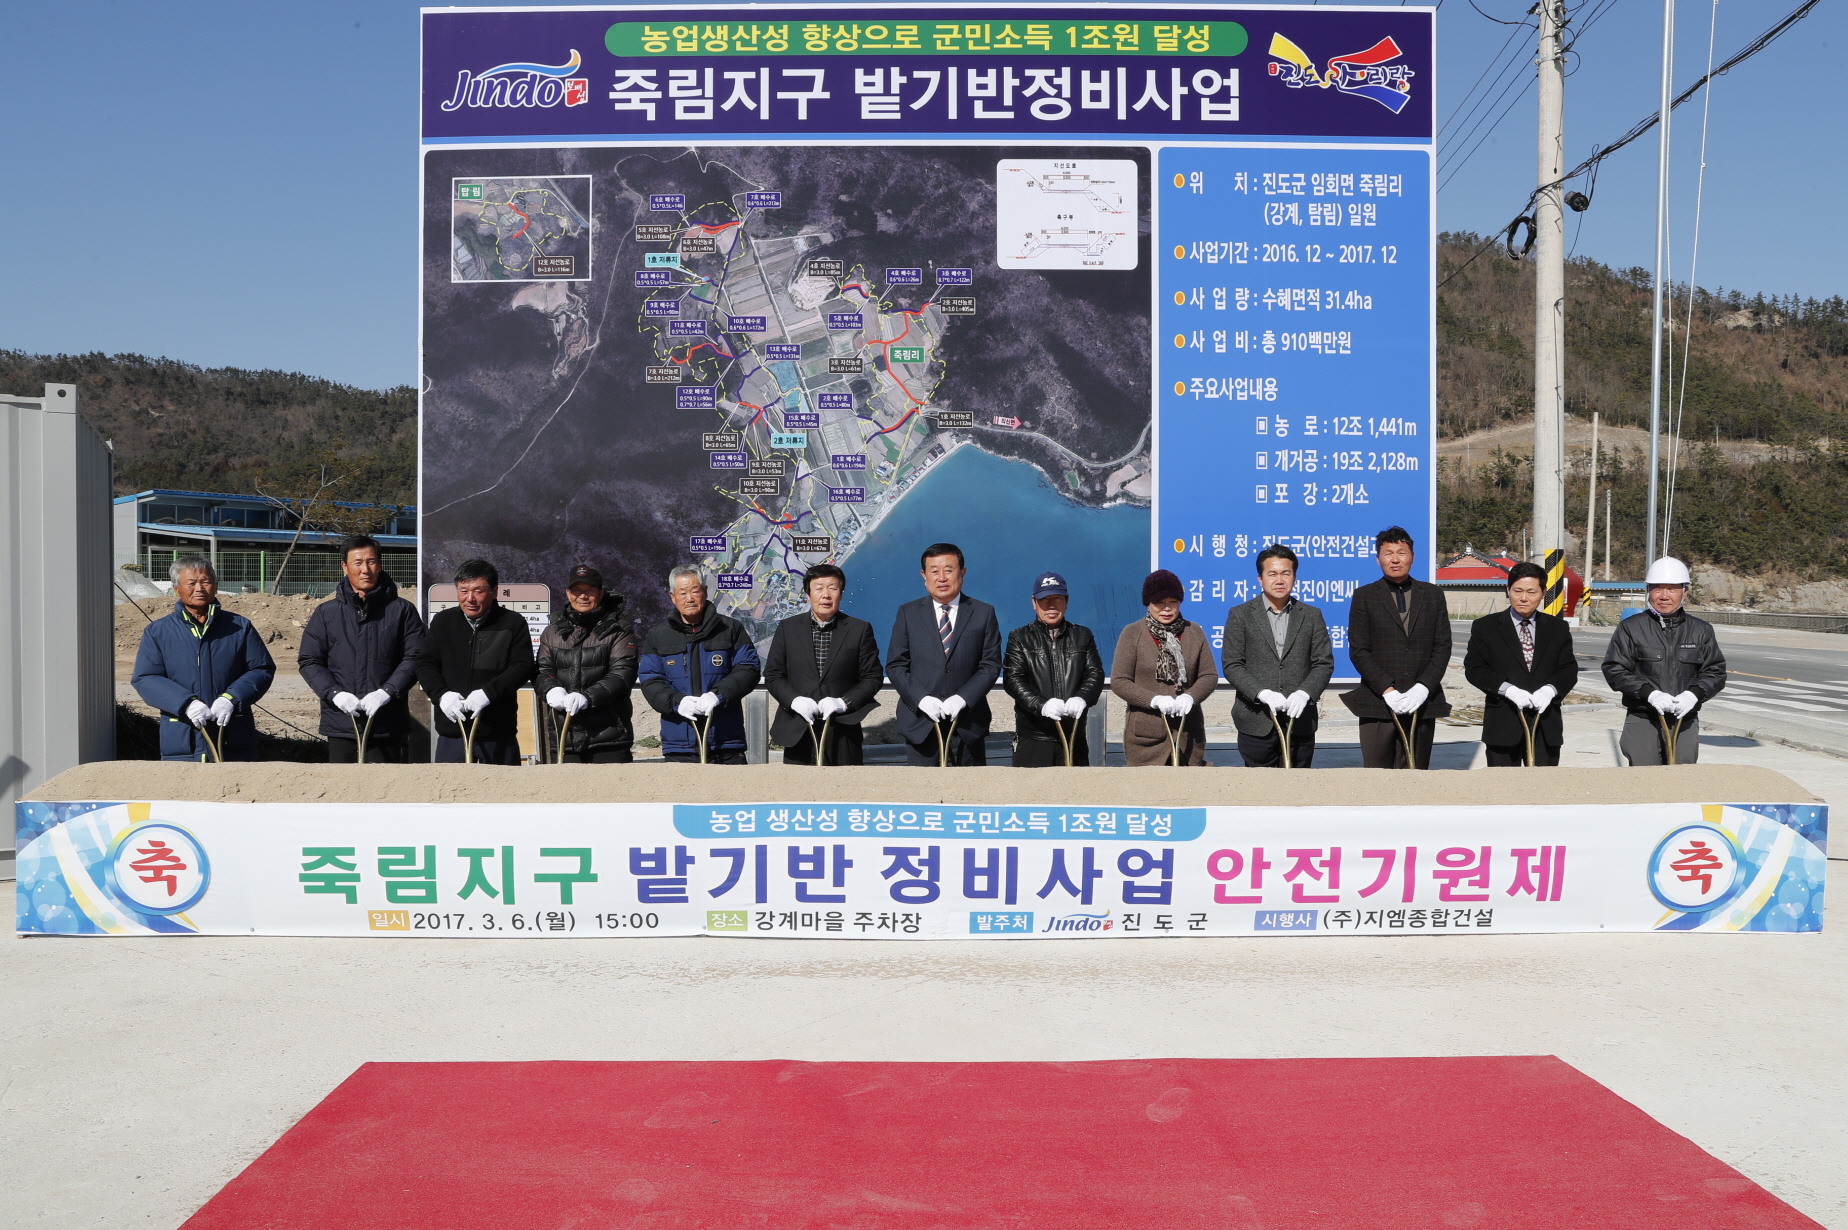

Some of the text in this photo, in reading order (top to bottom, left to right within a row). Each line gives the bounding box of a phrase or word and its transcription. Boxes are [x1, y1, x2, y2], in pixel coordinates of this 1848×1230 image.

[641, 23, 1210, 53] 농업생산성 향상으로 군민소득 1조원 달성
[441, 70, 565, 111] Jindo
[608, 66, 1241, 121] 죽림지구 밭기반정비사업
[1262, 172, 1307, 196] 진도군
[1311, 172, 1354, 197] 임회면
[1358, 173, 1402, 197] 죽림리
[1264, 201, 1304, 227] (강계,
[1347, 202, 1377, 227] 일원
[1189, 240, 1397, 265] 사업기간 2016. 12 2017. 12
[1262, 287, 1320, 312] 수혜면적
[1325, 290, 1373, 310] 31.4ha
[1261, 330, 1277, 354] 총
[1281, 330, 1352, 355] 910백만원
[893, 350, 920, 361] 죽림리
[1189, 377, 1279, 401] 주요사업내용
[1332, 416, 1363, 436] 12조
[1368, 417, 1417, 438] 1,441m
[1274, 449, 1419, 474] 개거공 19조 2,128m
[1331, 482, 1370, 506] 2개소
[709, 809, 1173, 837] 농업 생산성 향상으로 군민소득 1조원 달성
[129, 840, 187, 897] 축
[299, 845, 599, 905] 죽림지구
[882, 845, 1175, 905] 정비사업
[1206, 845, 1567, 905] 안전기원제
[1670, 840, 1723, 895] 축
[371, 911, 660, 932] 일시 2017. 3. 6.(월) 15:00
[711, 911, 923, 934] 장소 강계마을 주차장
[976, 913, 1028, 932] 발주처
[1042, 917, 1102, 933] Jindo
[1261, 908, 1495, 930] 시행사 (주)지엠종합건설
